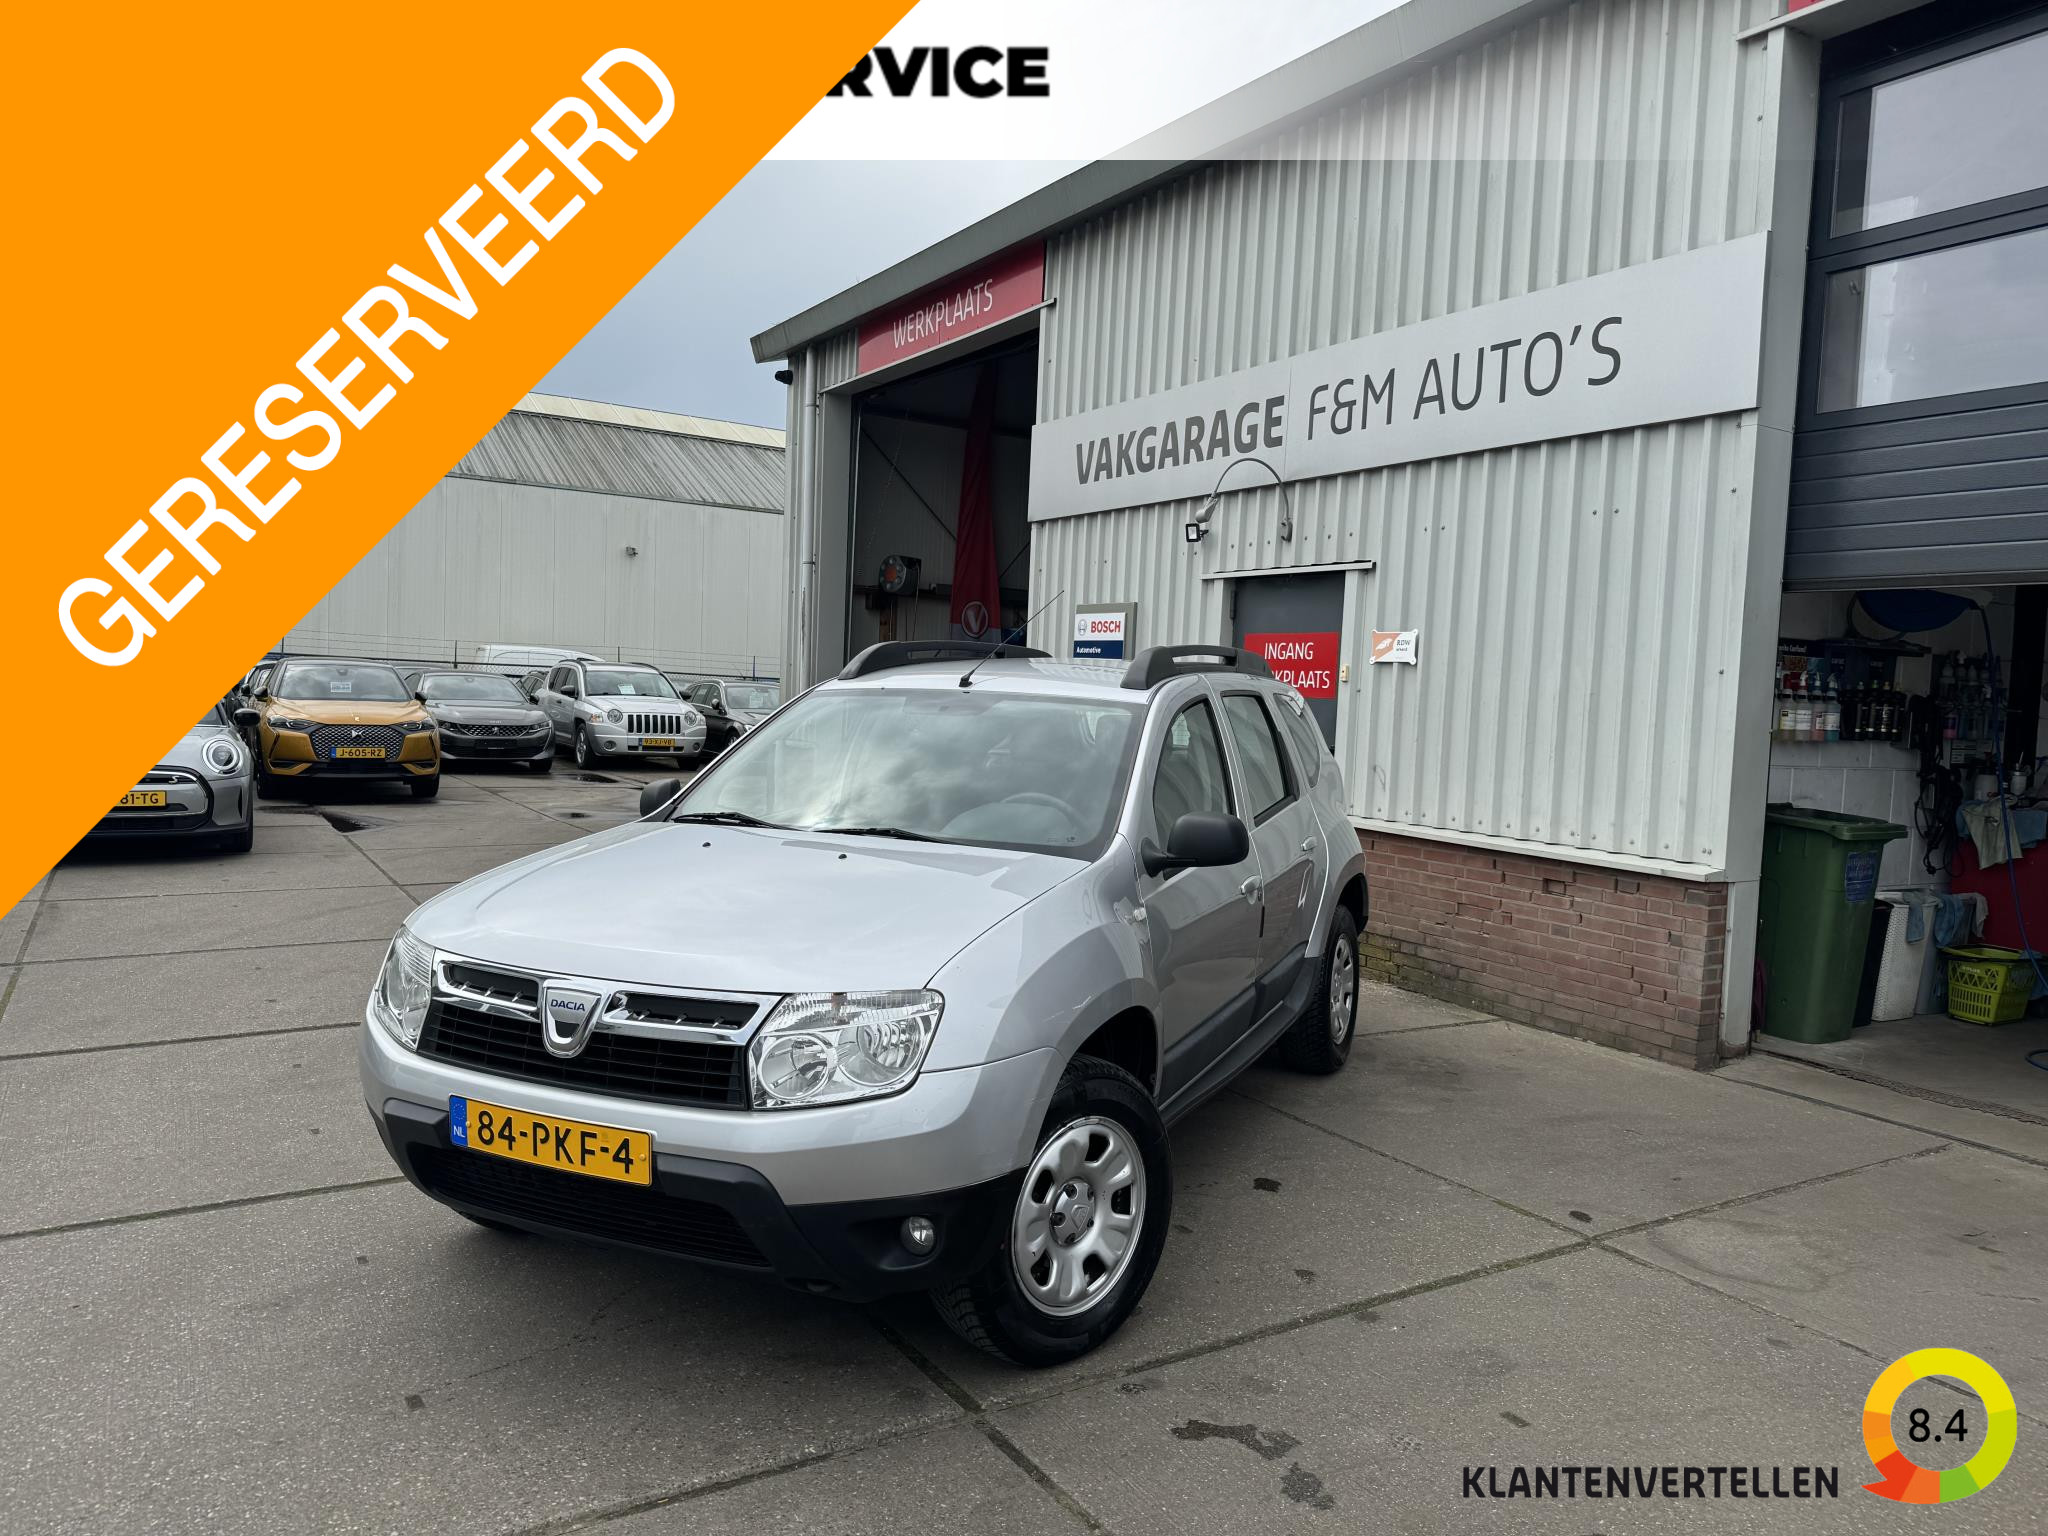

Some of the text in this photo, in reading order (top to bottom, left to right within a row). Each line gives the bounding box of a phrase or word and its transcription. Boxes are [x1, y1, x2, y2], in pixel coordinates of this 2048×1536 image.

[893, 279, 993, 349] WERKPLAATS
[1076, 316, 1623, 485] VAKGARAGE F&M AUTO'S
[1090, 620, 1121, 634] BOSCH
[1264, 641, 1314, 660] INGANG
[1271, 669, 1331, 689] KPLAATS
[339, 748, 383, 757] J-605-RZ
[120, 793, 159, 805] 81-TG
[550, 998, 586, 1012] DACIA
[453, 1110, 634, 1175] NL 84-PKF-4
